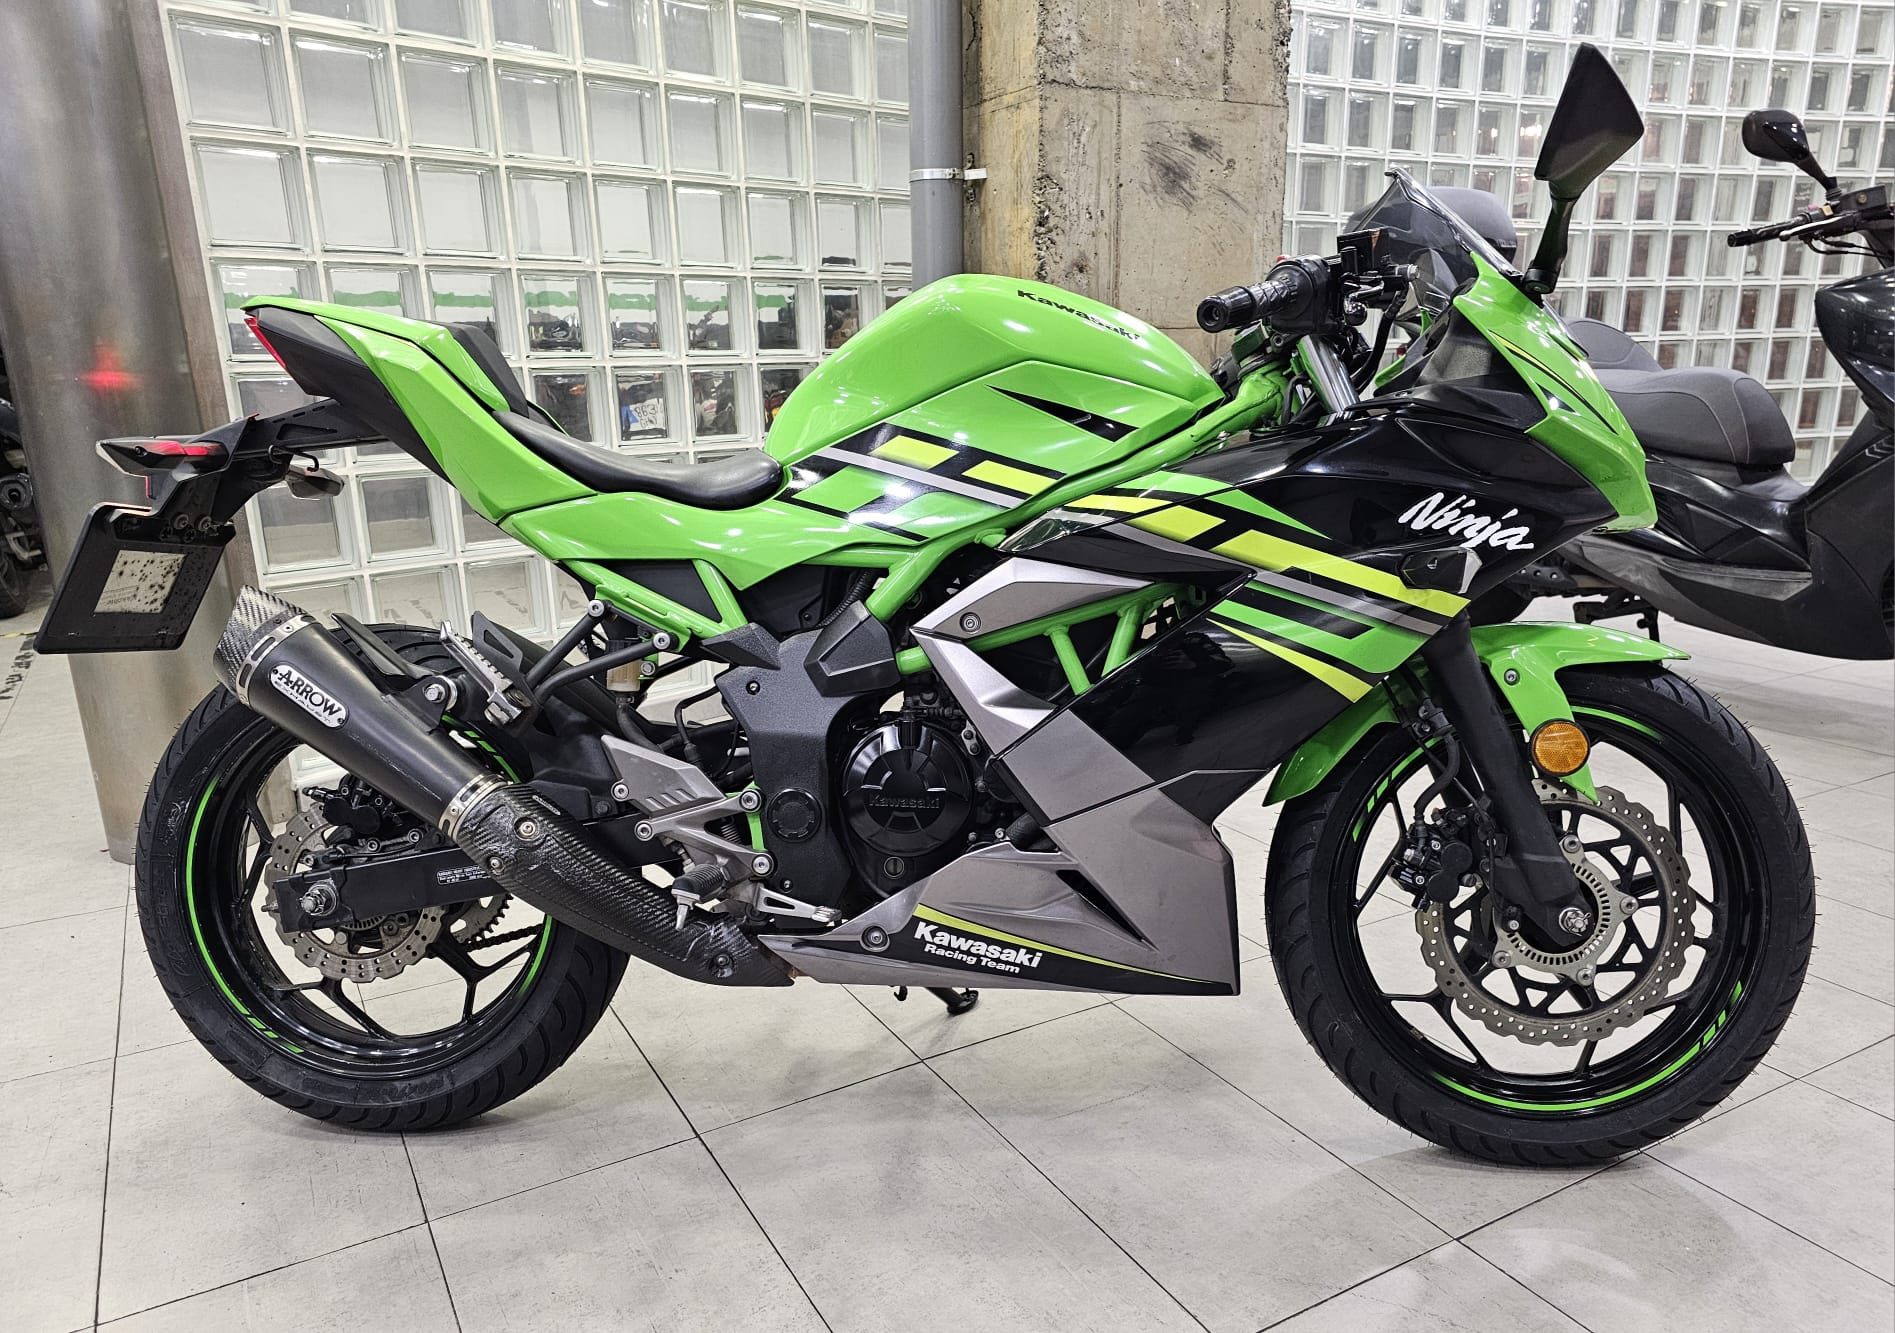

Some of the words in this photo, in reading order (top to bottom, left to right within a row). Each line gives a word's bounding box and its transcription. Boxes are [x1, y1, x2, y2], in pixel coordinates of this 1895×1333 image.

[1398, 492, 1535, 550] Ninja
[277, 669, 342, 716] ARROW
[868, 793, 940, 809] Kawasaki
[914, 921, 1043, 968] Kawasaki
[924, 943, 978, 965] Racing
[980, 956, 1020, 974] Team
